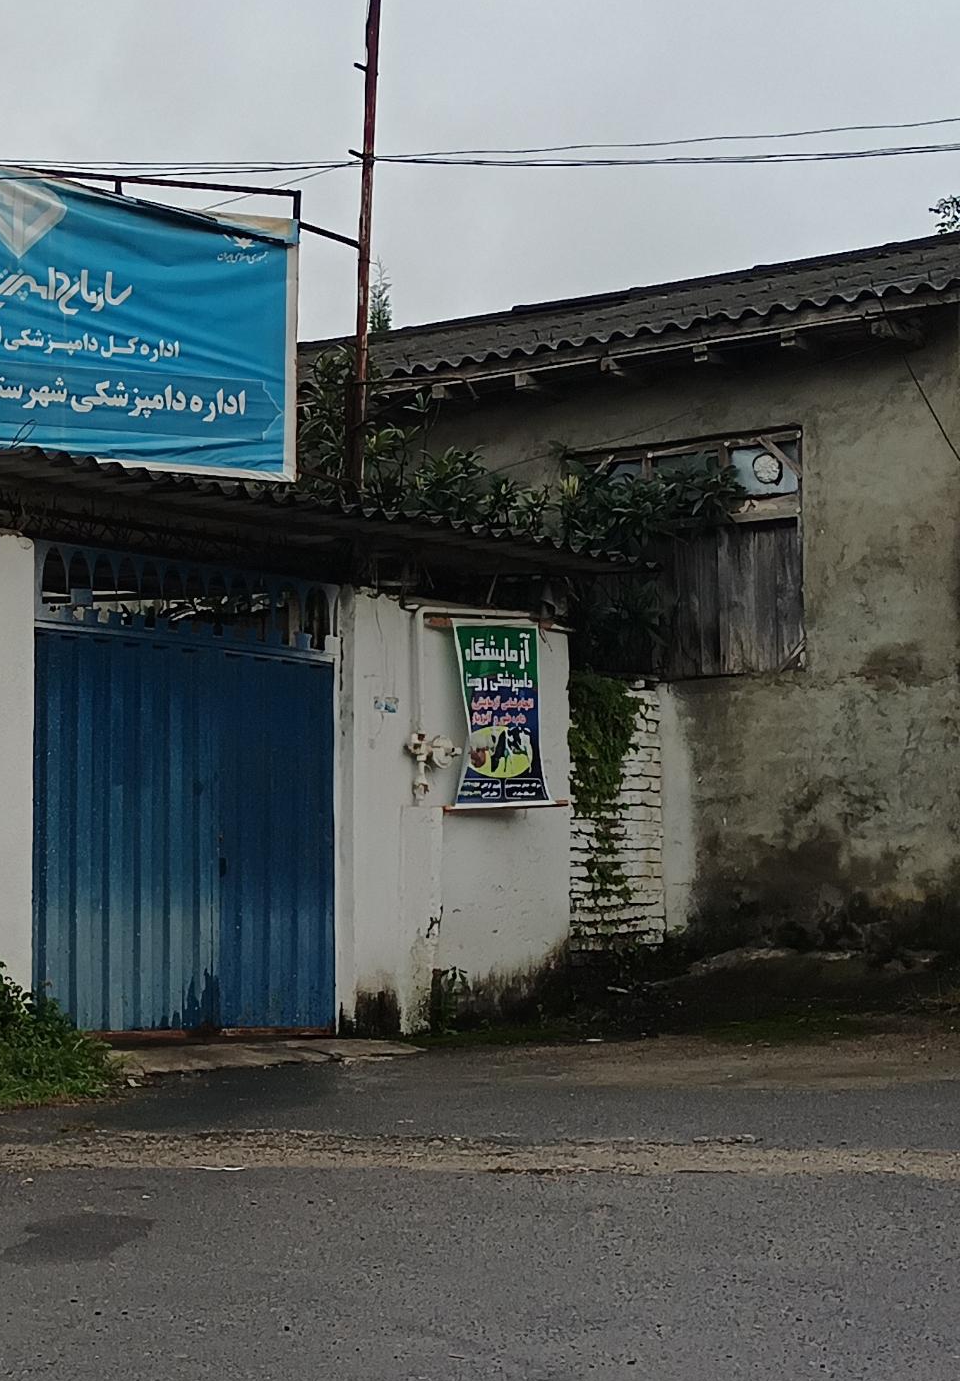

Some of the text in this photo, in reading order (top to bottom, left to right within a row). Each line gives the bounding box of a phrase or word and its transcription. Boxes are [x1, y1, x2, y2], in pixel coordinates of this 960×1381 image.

[58, 269, 132, 315] سازمان
[4, 329, 98, 356] دامپزشکی
[100, 336, 139, 355] کل
[140, 339, 180, 362] اداره
[70, 380, 187, 418] دامپزشکی
[189, 388, 247, 422] اداره
[465, 633, 530, 669] آزمایشگاه
[490, 671, 533, 695] دامپزشکی
